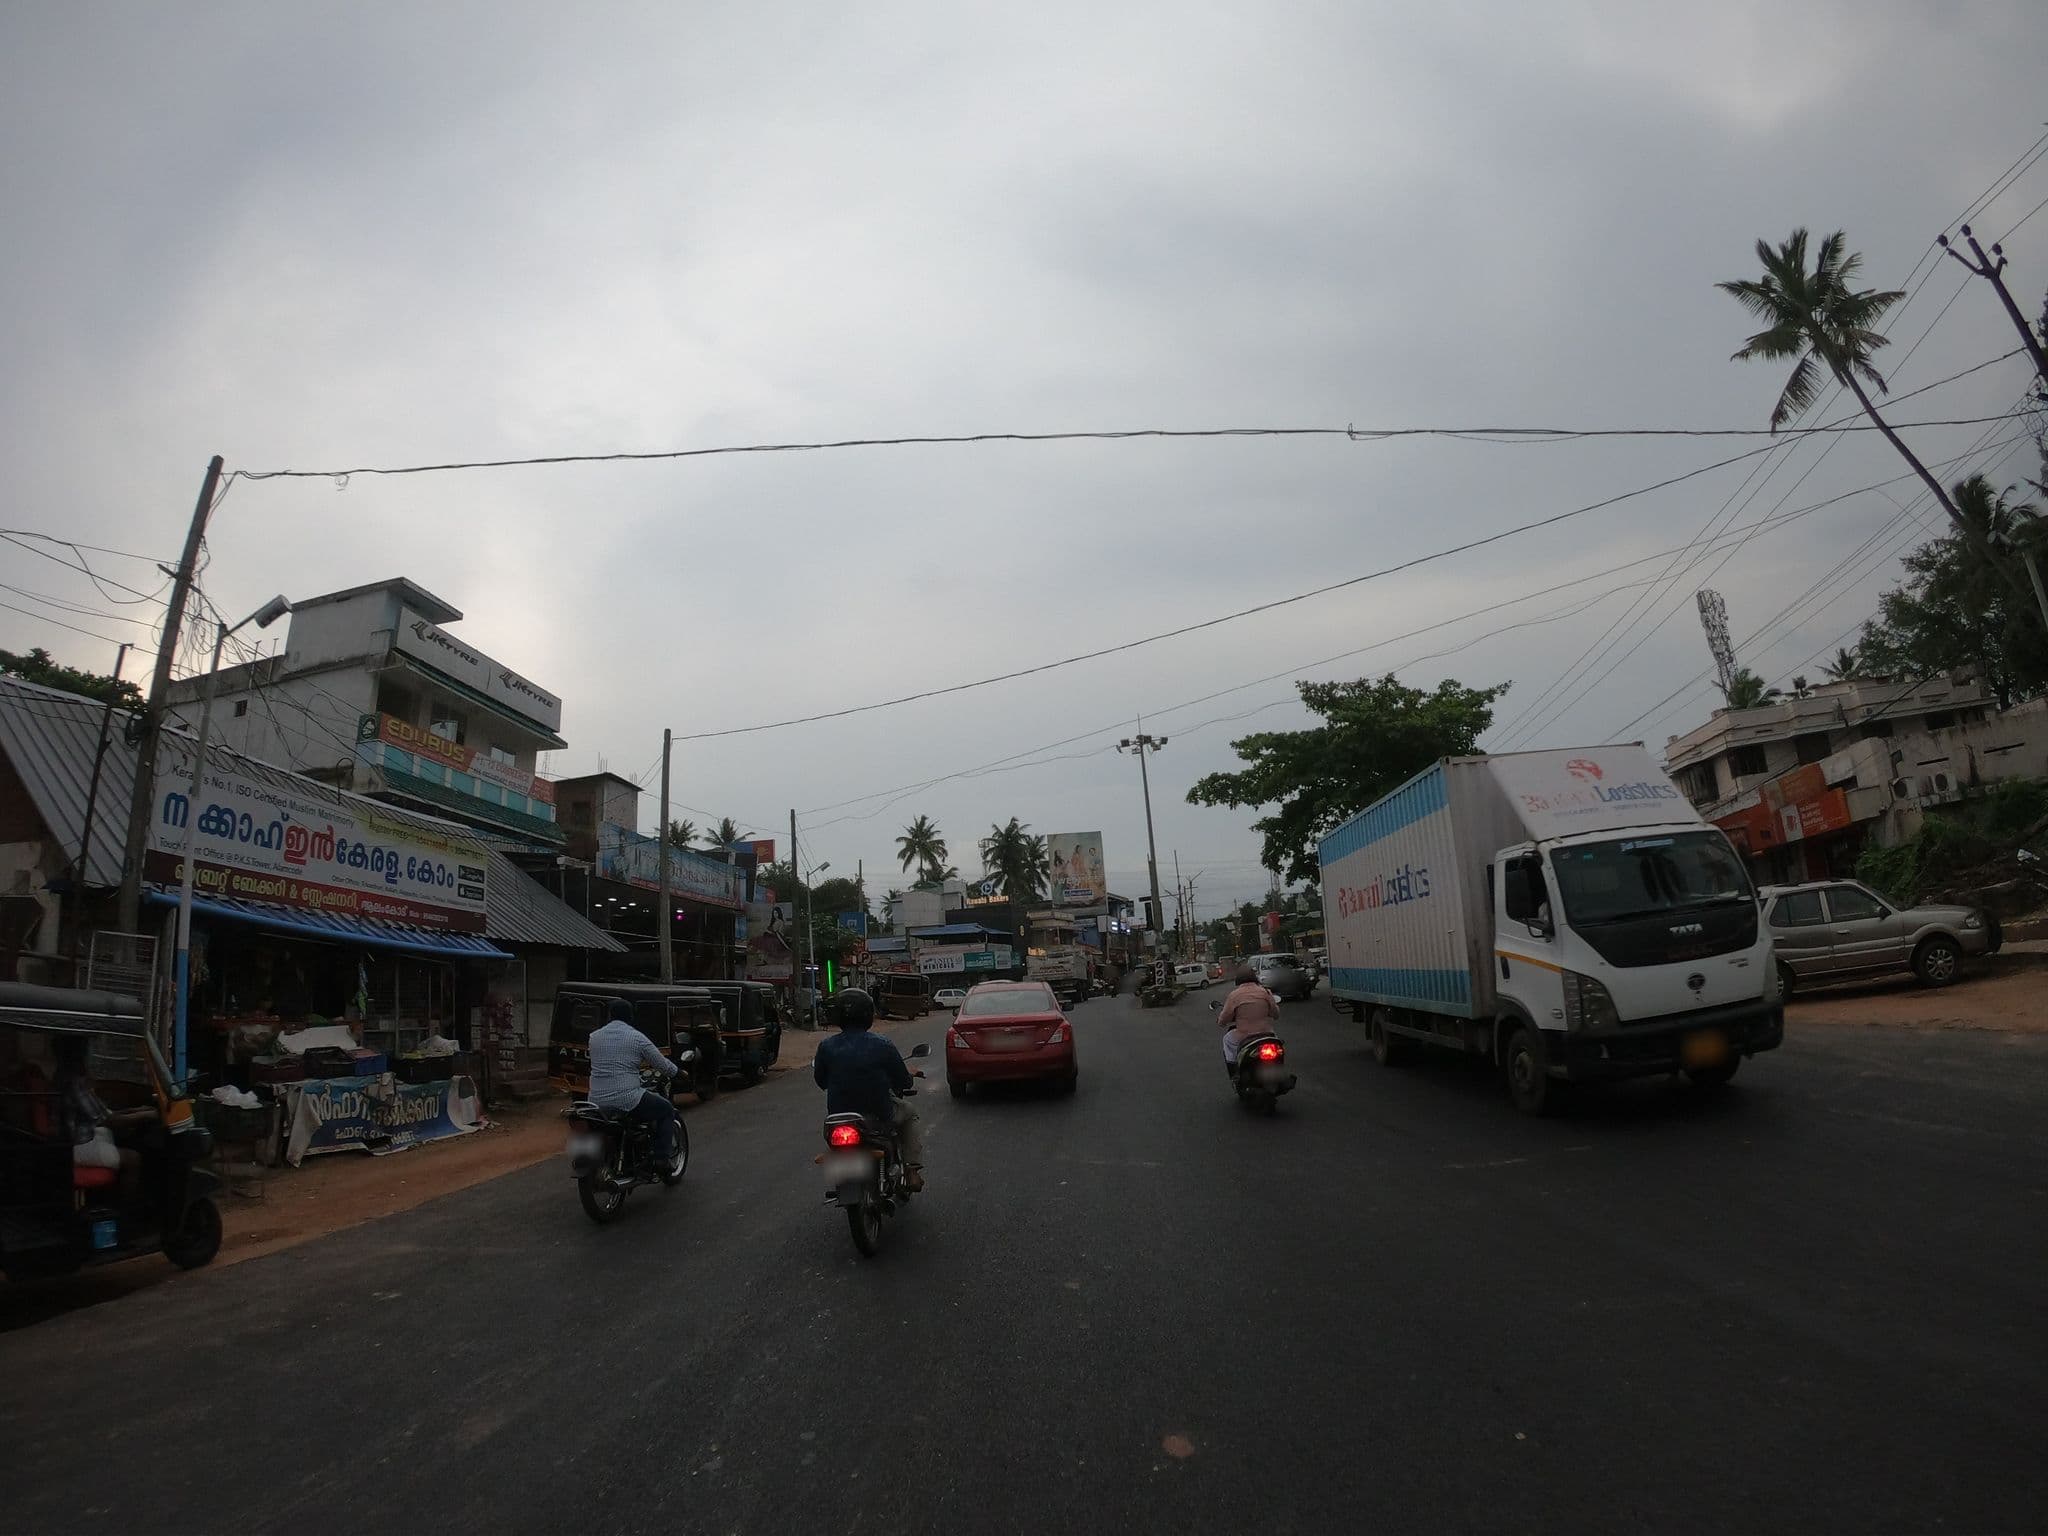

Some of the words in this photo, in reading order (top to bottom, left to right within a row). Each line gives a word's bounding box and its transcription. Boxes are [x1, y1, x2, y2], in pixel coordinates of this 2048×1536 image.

[1592, 782, 1680, 804] Logistics
[236, 784, 252, 798] ISO
[253, 789, 288, 809] Certified
[289, 800, 316, 816] Muslim
[318, 808, 355, 829] Matrimony
[160, 837, 182, 850] Touch
[202, 847, 225, 861] Office
[289, 884, 298, 900] &
[1669, 923, 1704, 936] TATA
